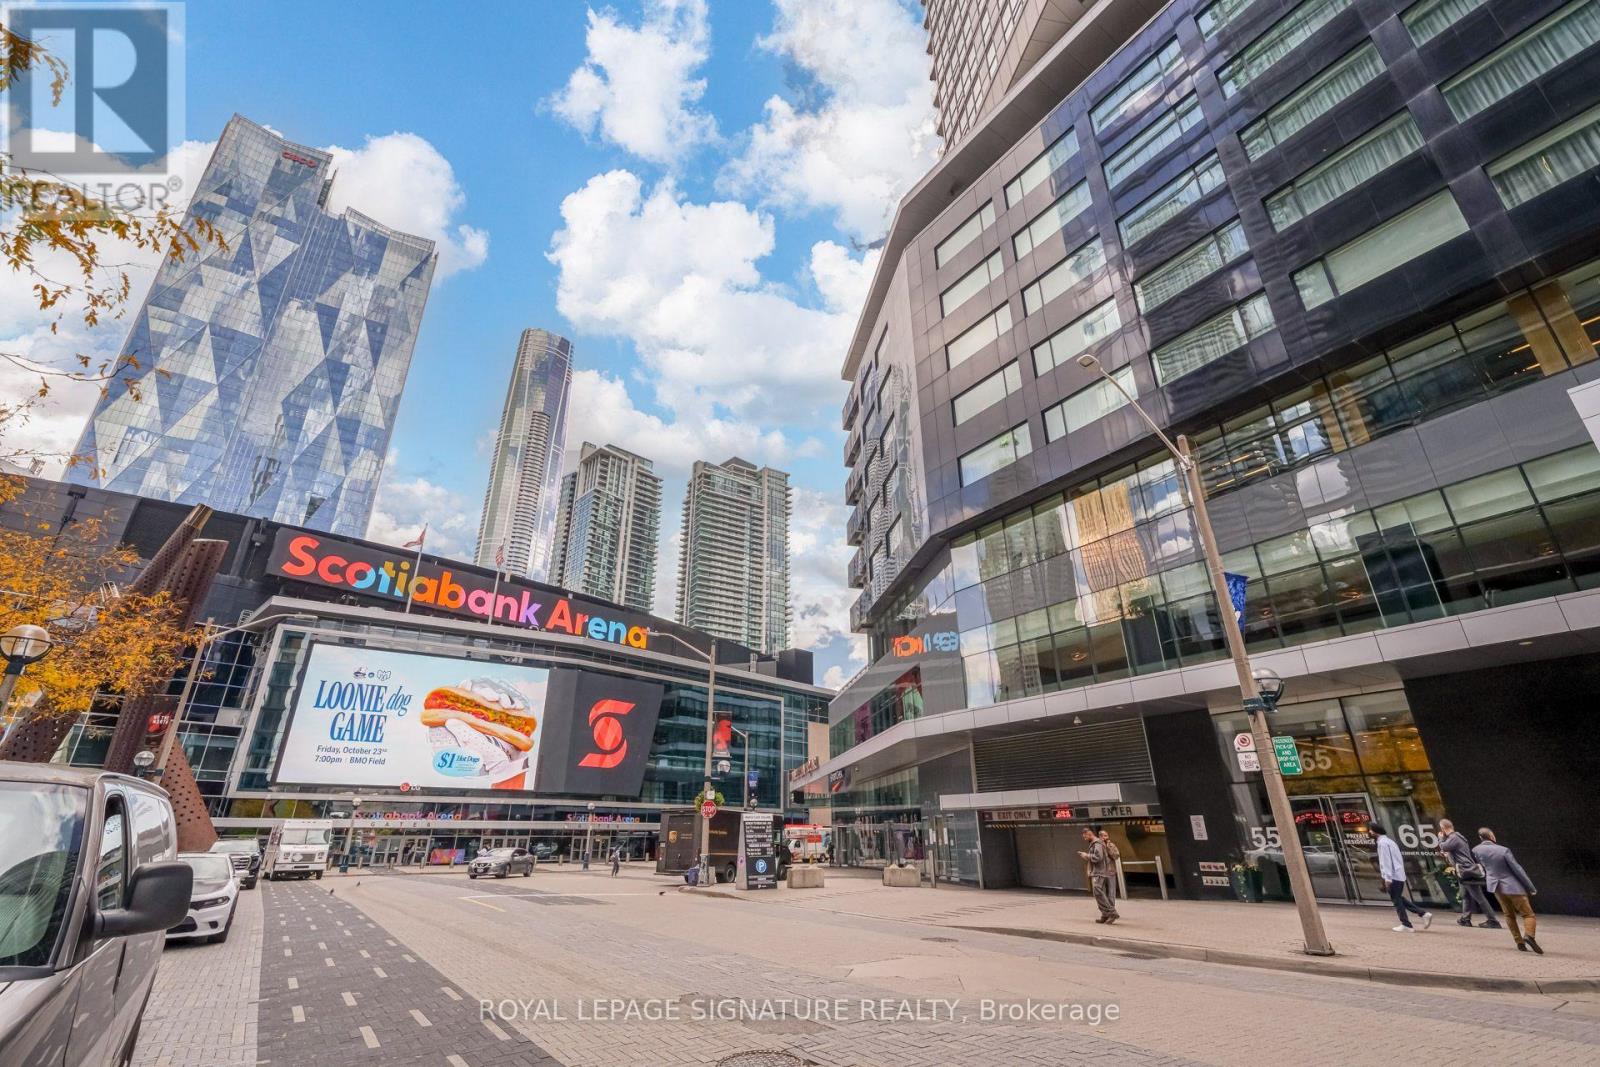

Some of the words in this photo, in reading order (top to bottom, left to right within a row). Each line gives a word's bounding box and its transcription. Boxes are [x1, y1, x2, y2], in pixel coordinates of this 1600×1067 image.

[281, 535, 542, 626] Scotiabank
[545, 599, 649, 650] Arena
[313, 680, 387, 713] LOONIE
[386, 685, 413, 717] dog
[330, 711, 387, 743] GAME
[314, 754, 342, 764] 7:00pm
[368, 757, 386, 765] Field
[316, 745, 341, 754] Friday,
[343, 746, 371, 755] October
[437, 751, 456, 768] $1
[1300, 749, 1332, 771] 65
[355, 811, 423, 820] Scotiabank
[427, 812, 462, 820] Arena
[997, 810, 1013, 820] EXIT
[1014, 810, 1032, 819] ONLY
[1101, 806, 1133, 816] ENTER
[1250, 826, 1282, 848] 55
[1398, 823, 1439, 849] 65
